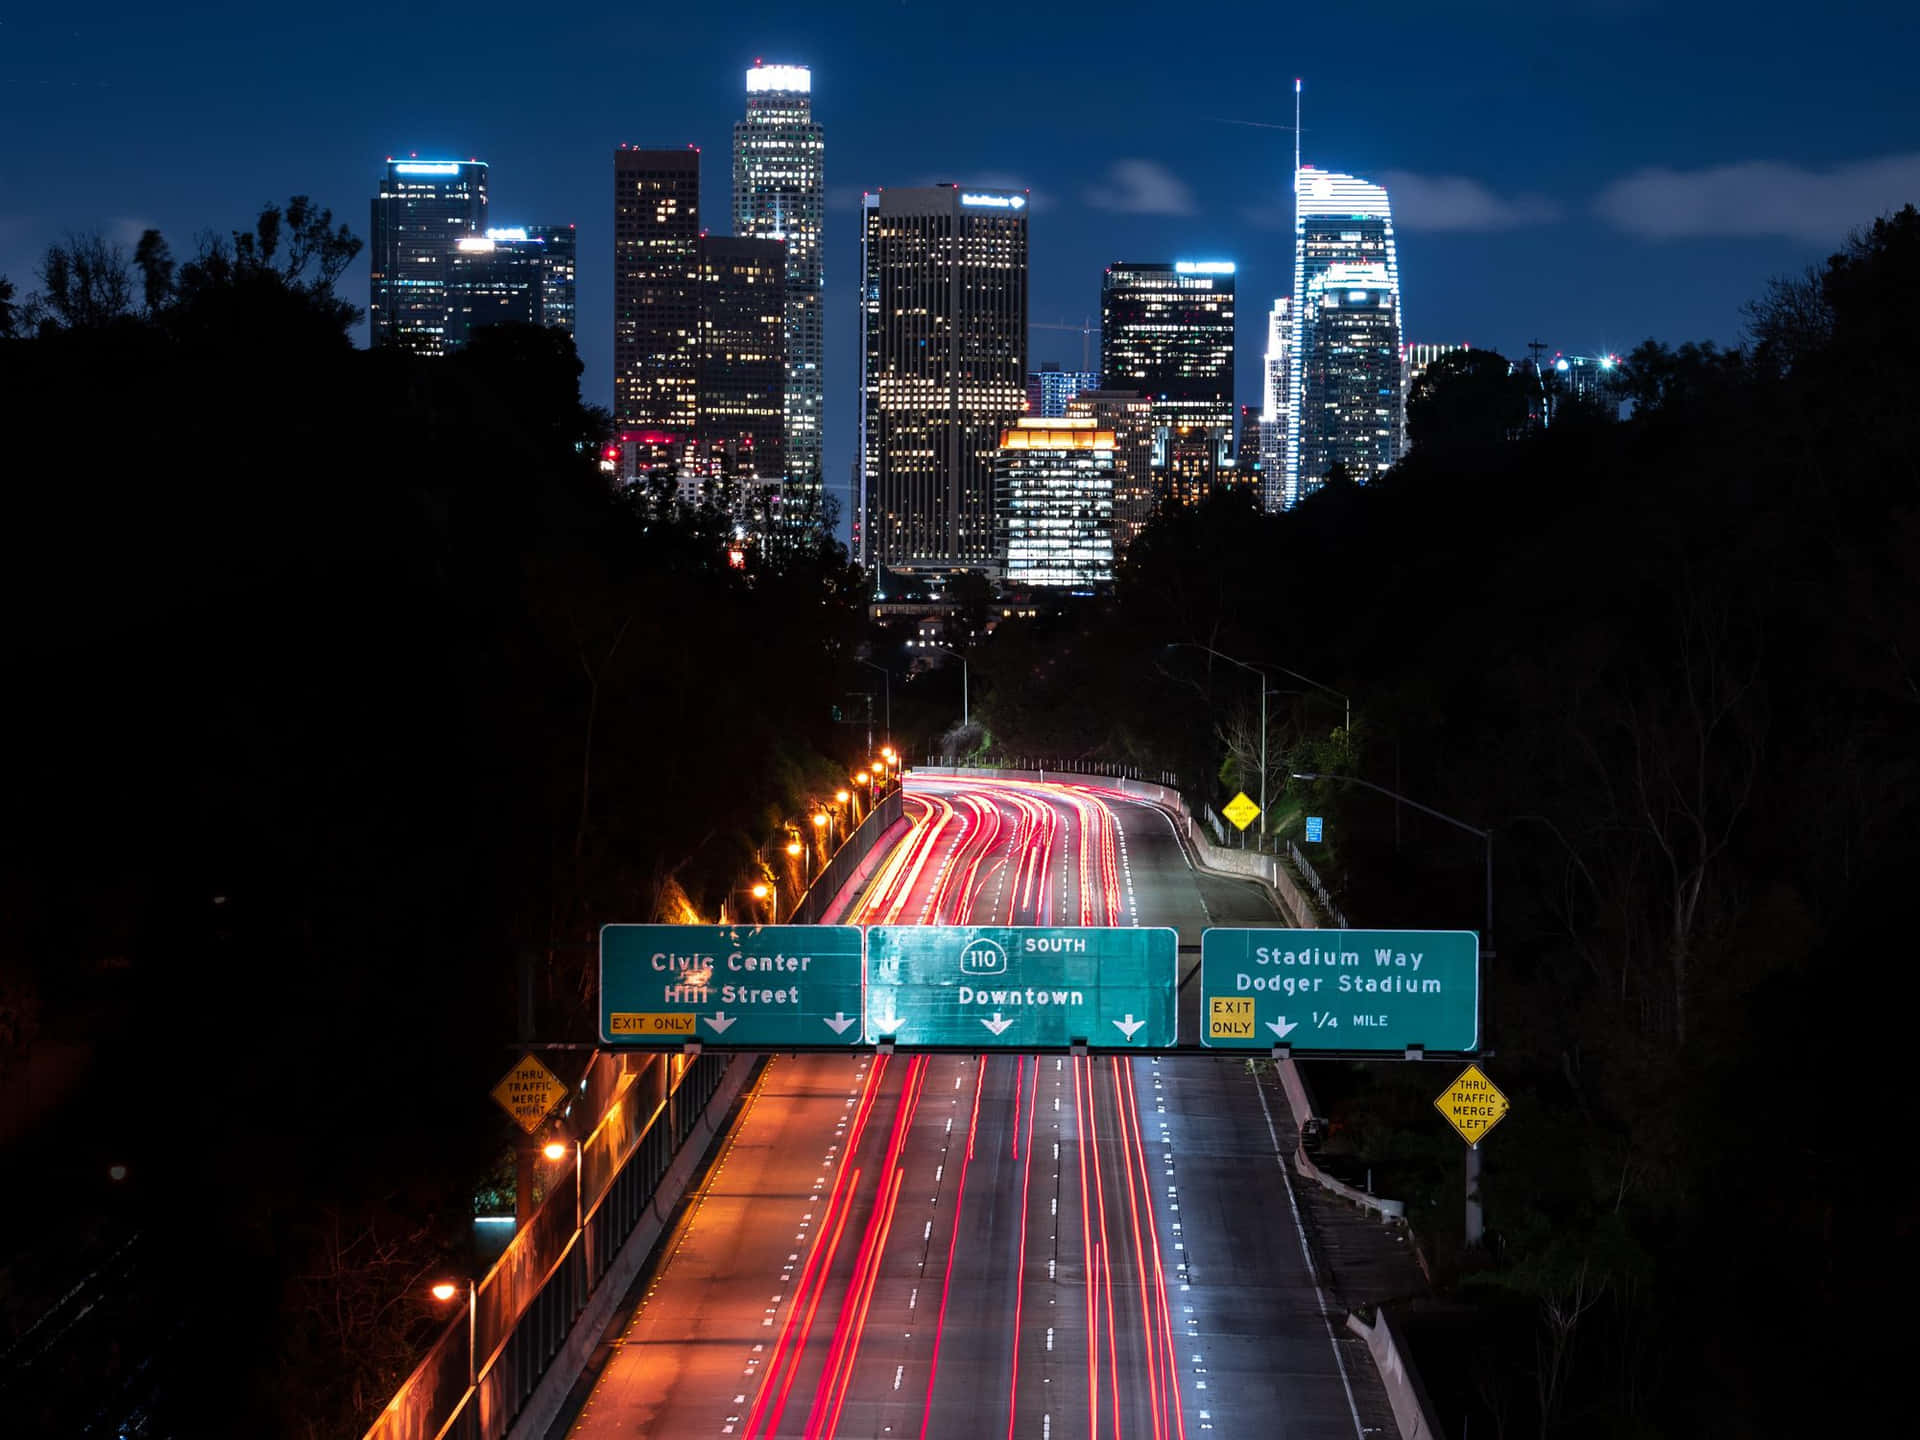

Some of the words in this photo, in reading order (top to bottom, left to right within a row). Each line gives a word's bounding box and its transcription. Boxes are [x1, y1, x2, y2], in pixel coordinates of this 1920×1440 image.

[1025, 938, 1086, 952] SOUTH
[651, 953, 714, 971] Civic
[728, 954, 811, 971] Center
[971, 951, 996, 967] 110
[1256, 947, 1359, 966] Stadium
[1375, 949, 1423, 970] Way
[1237, 974, 1323, 996] Dodger
[1339, 976, 1441, 992] Stadium
[664, 985, 708, 1003] Hill
[722, 985, 798, 1003] Street
[960, 987, 1083, 1005] Downtown
[1214, 1002, 1250, 1013] EXIT
[612, 1018, 645, 1029] EXIT
[654, 1018, 692, 1030] ONLY
[1353, 1015, 1388, 1026] MILE
[1212, 1022, 1251, 1034] ONLY
[517, 1071, 543, 1079] THRU
[509, 1082, 551, 1091] TRAFFIC
[1460, 1081, 1487, 1090] THRU
[512, 1094, 547, 1103] MERGE
[1452, 1093, 1495, 1103] TRAFFIC
[1454, 1106, 1494, 1116] MERGE
[1460, 1120, 1487, 1128] LEFT
